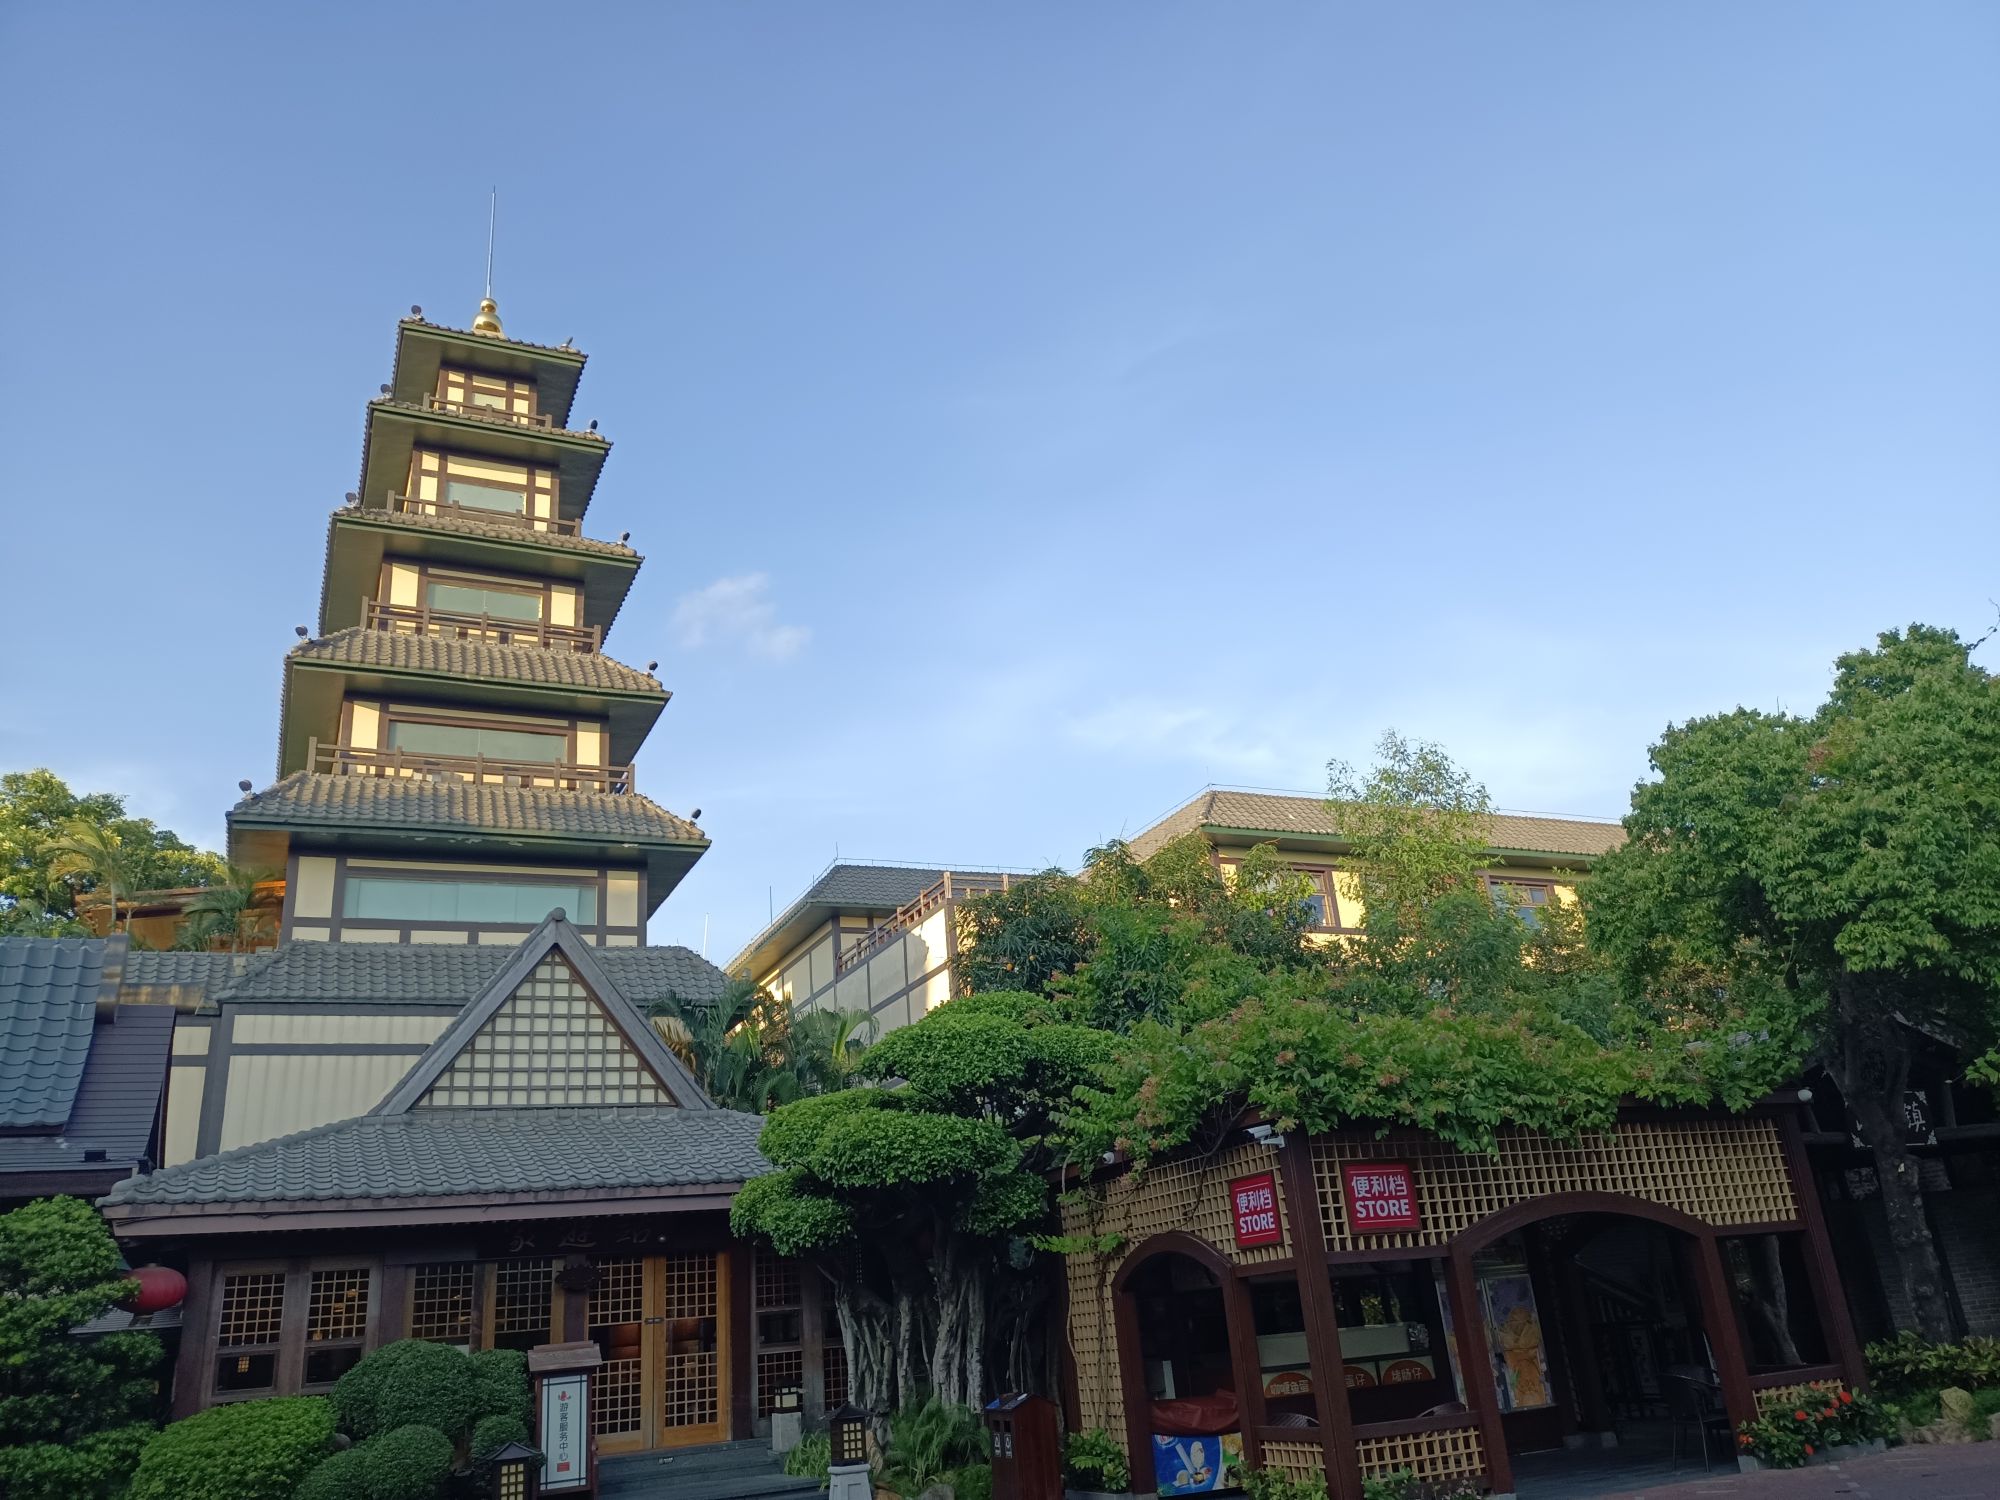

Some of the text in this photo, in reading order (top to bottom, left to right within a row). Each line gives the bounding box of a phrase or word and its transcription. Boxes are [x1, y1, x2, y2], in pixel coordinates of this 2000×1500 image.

[1352, 1175, 1407, 1198] 便利档
[1237, 1188, 1272, 1213] 便利档
[1356, 1199, 1411, 1219] STORE
[1240, 1212, 1275, 1234] STORE
[559, 1402, 569, 1462] 游客服务中心
